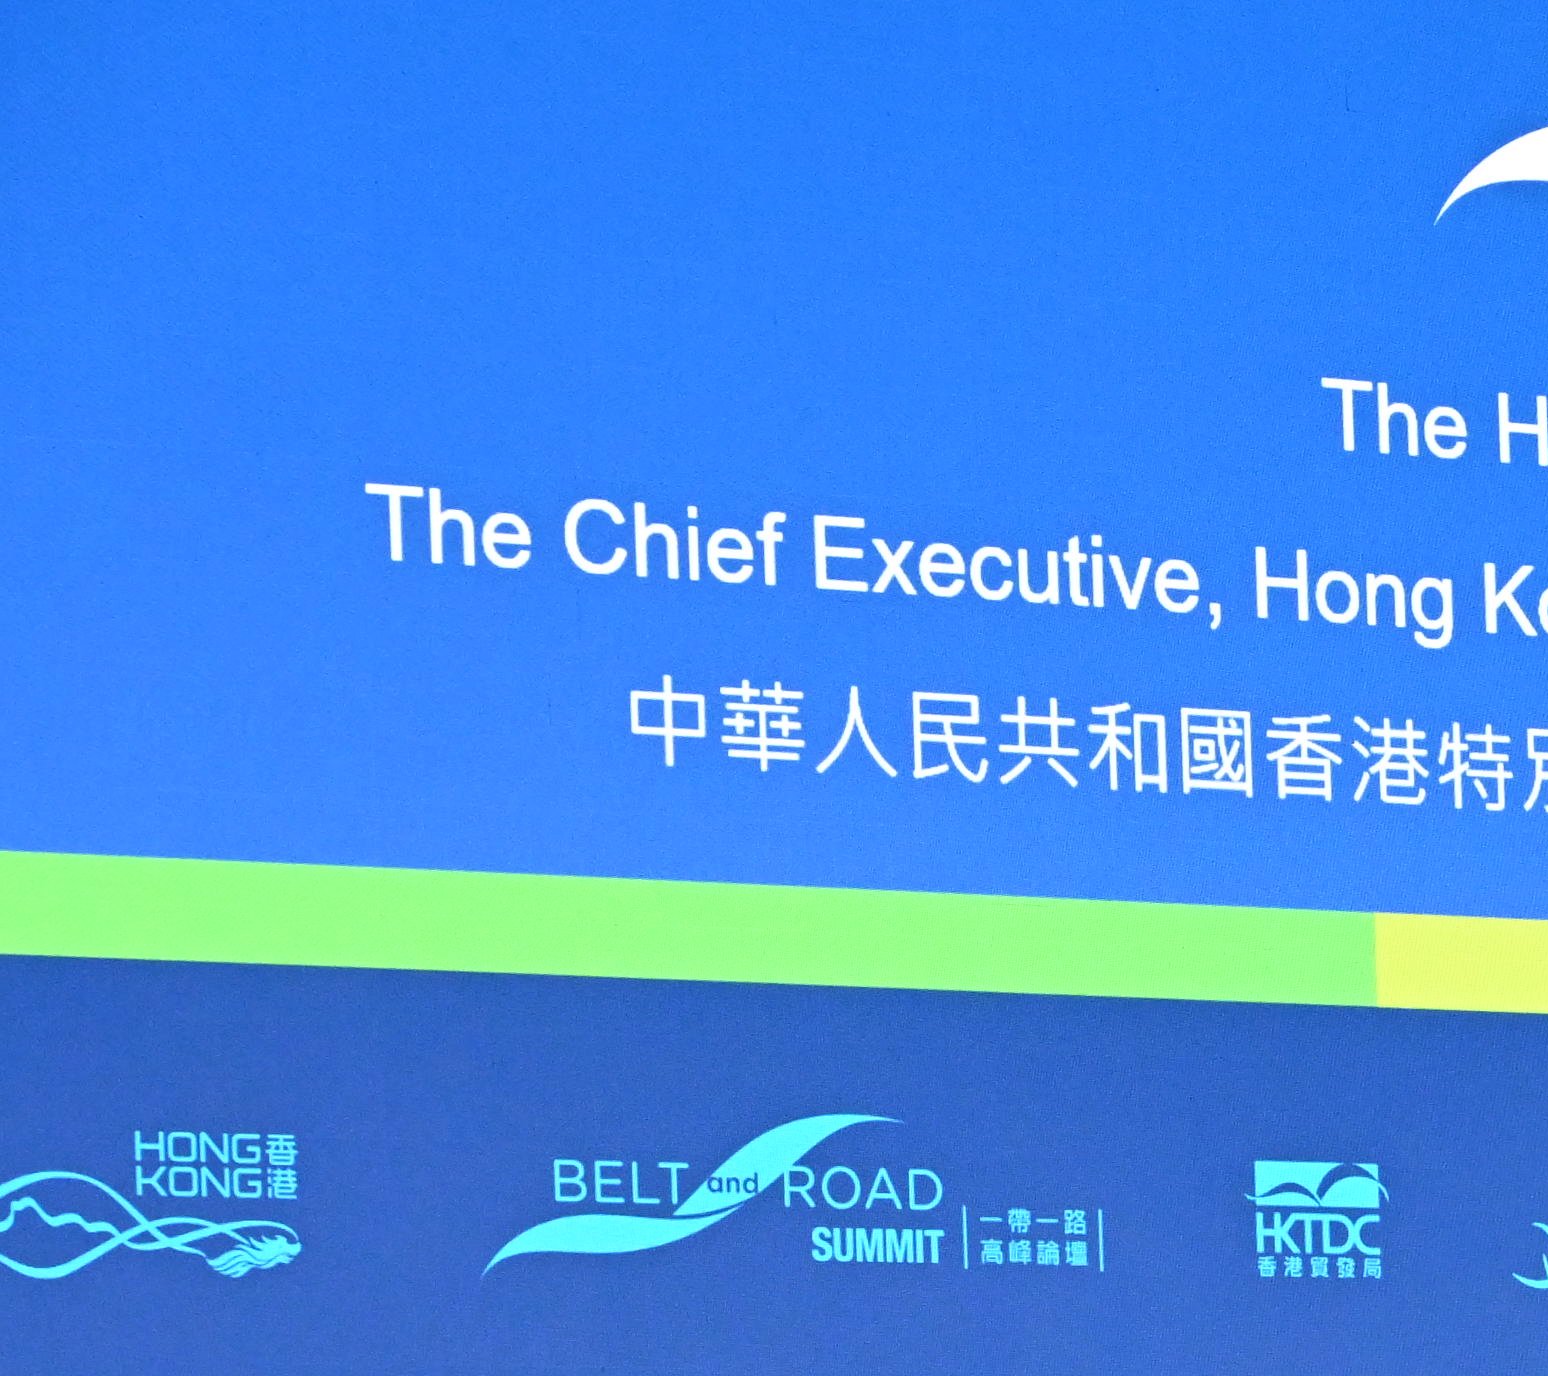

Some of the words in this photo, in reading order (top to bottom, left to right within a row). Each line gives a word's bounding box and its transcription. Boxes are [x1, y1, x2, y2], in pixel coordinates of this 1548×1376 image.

[1322, 378, 1467, 458] The
[365, 483, 531, 568] The
[565, 499, 786, 585] Chief
[814, 515, 1221, 629] Executive,
[1256, 547, 1453, 648] Hong
[553, 1159, 689, 1205] BELT
[705, 1168, 760, 1195] and
[780, 1160, 942, 1210] ROAD
[980, 1209, 1086, 1234] 一帶一路
[1256, 1213, 1381, 1257] HKTDC
[812, 1227, 944, 1263] SUMMIT
[981, 1239, 1087, 1265] 高峰論壇
[1258, 1257, 1381, 1278] 香港貿發局
